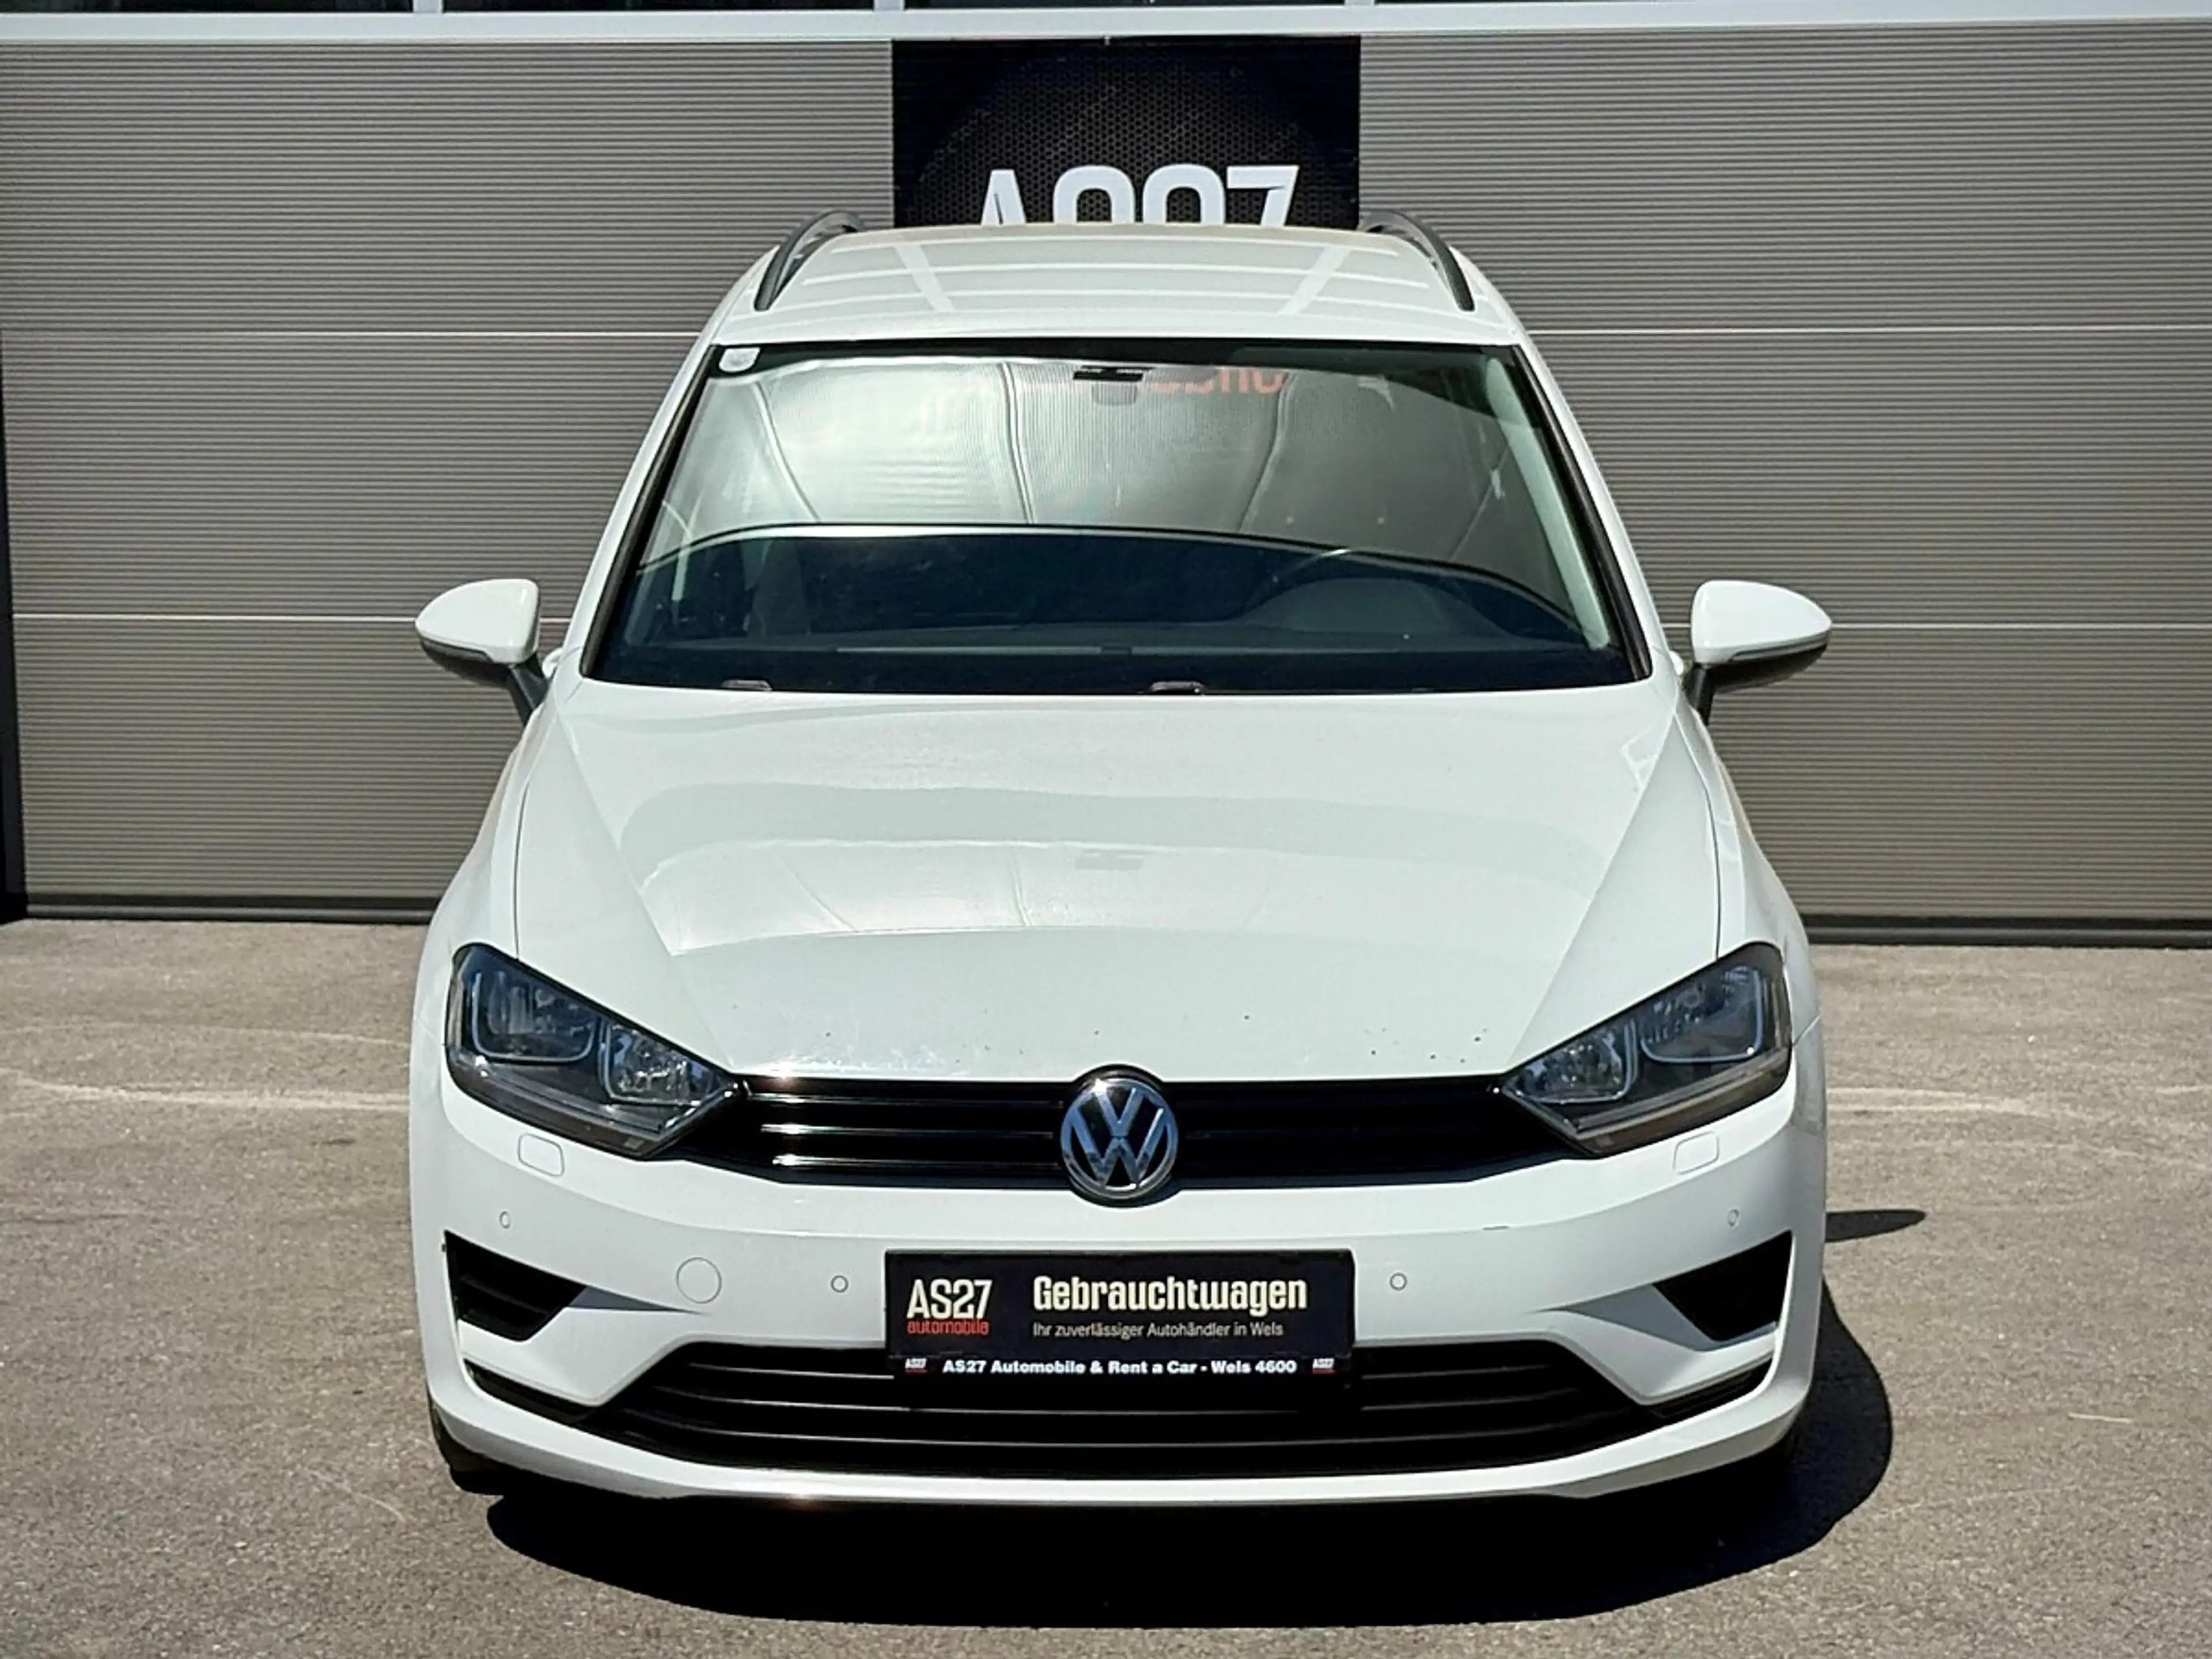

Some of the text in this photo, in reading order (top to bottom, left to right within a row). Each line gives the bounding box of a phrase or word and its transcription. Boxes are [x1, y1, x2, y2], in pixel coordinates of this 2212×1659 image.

[906, 1278, 993, 1320] AS27
[1033, 1275, 1308, 1317] Gebrauchtwagen
[907, 1320, 990, 1335] automobile
[1033, 1321, 1284, 1340] Ihr zuverlässiger Autohändler in Wels
[942, 1359, 987, 1373] AS27
[990, 1359, 1086, 1374] Automobile
[1089, 1360, 1104, 1374] &
[1108, 1360, 1148, 1374] Rent
[1152, 1363, 1164, 1374] a
[1166, 1360, 1198, 1374] Car
[1210, 1360, 1252, 1374] Wels
[1255, 1359, 1297, 1374] 4600
